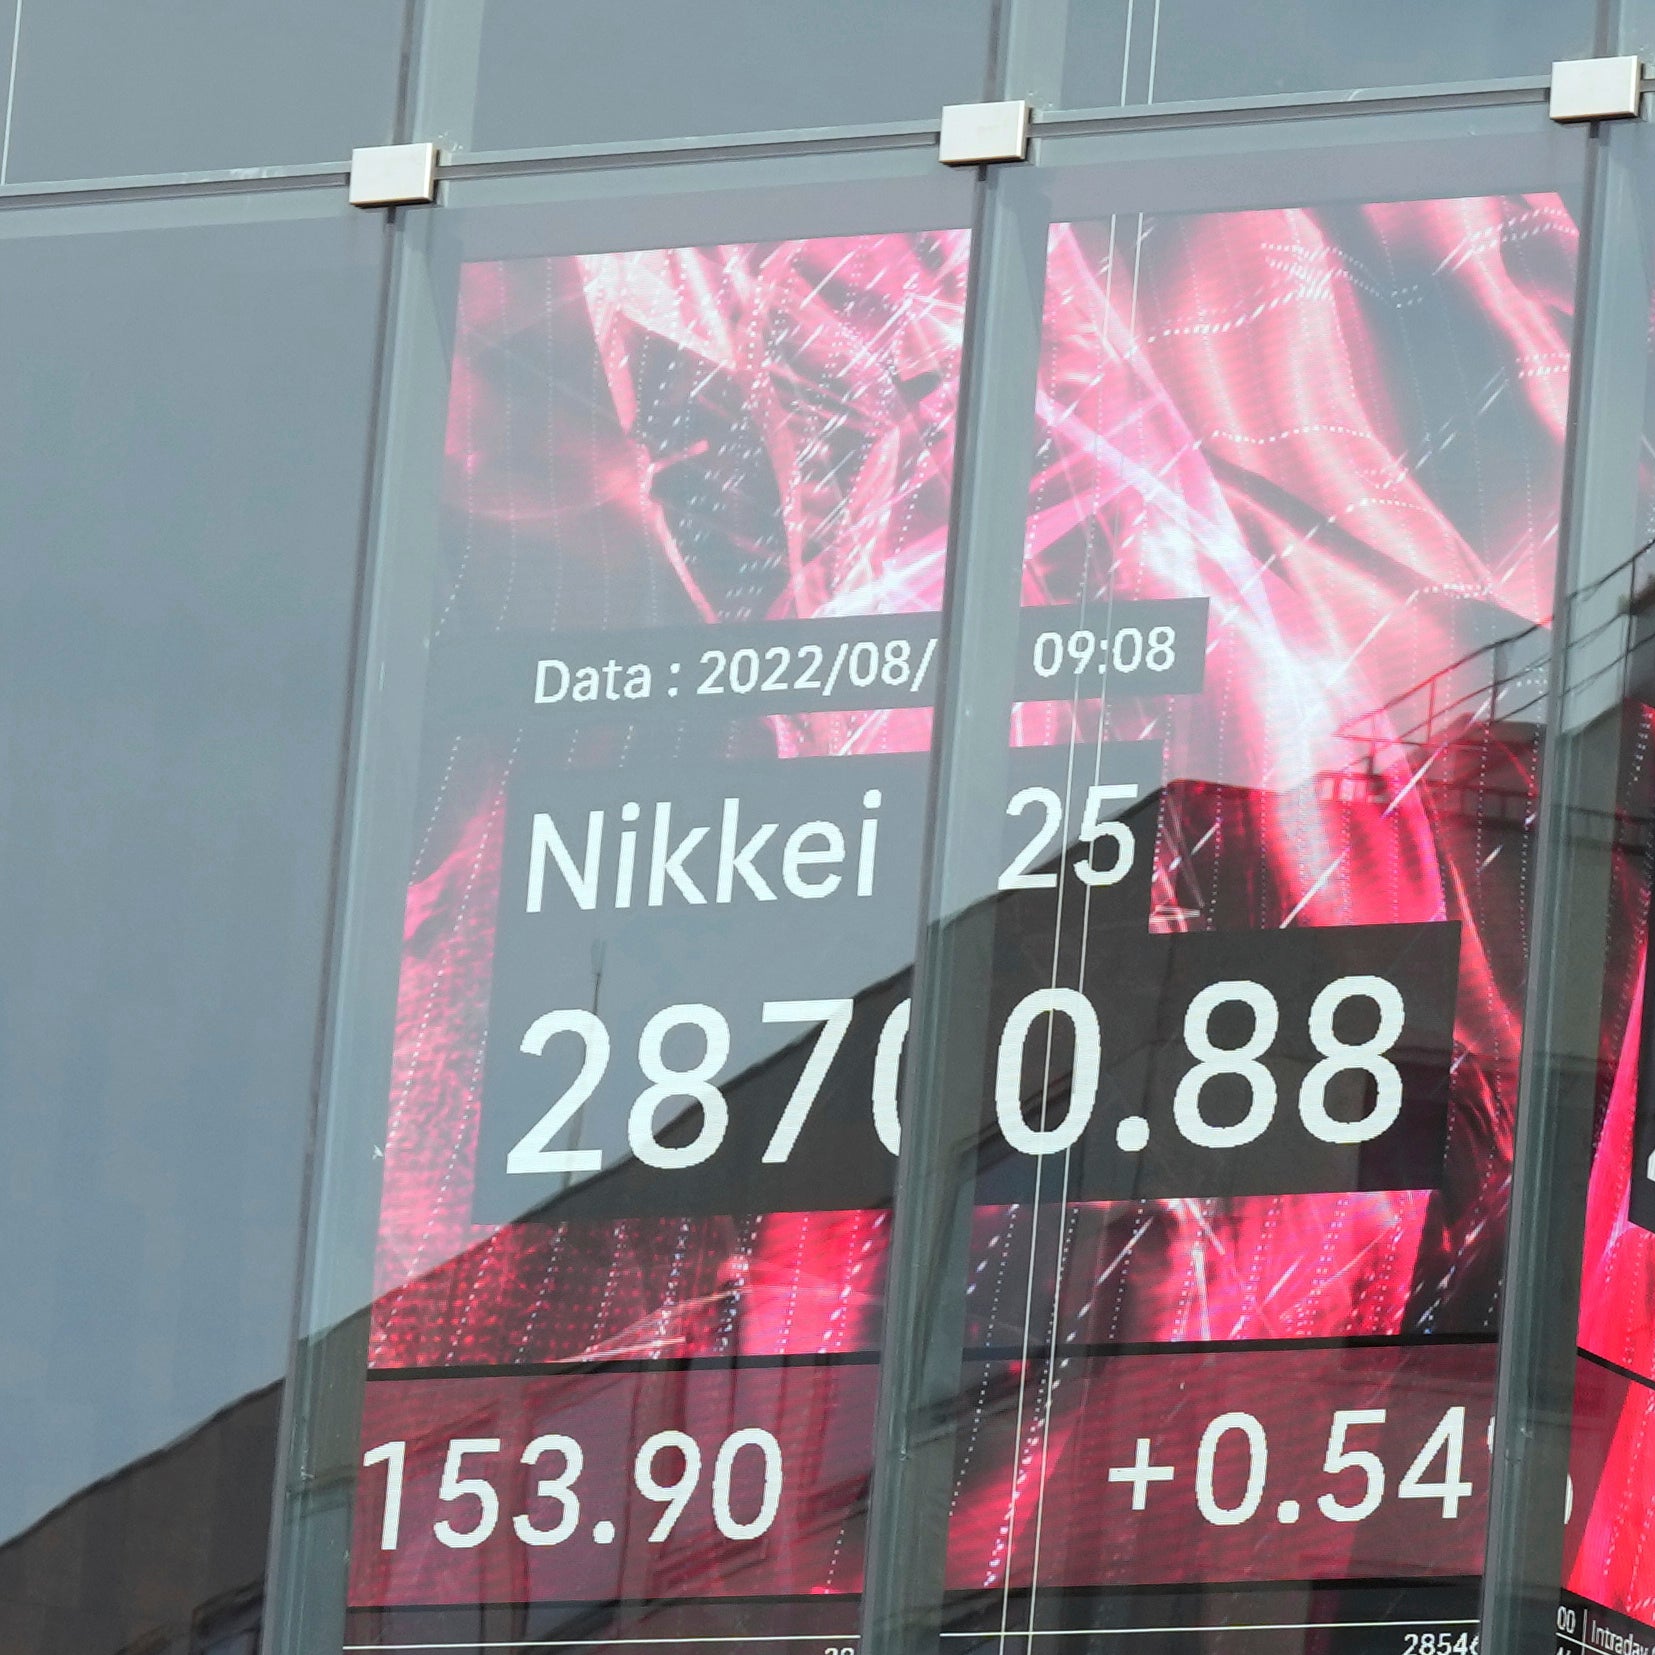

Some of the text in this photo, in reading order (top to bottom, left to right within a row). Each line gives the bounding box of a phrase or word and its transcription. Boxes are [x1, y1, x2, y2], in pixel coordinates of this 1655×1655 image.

[533, 658, 653, 704] Data
[696, 637, 939, 697] 2022/08/
[1032, 625, 1177, 678] 09:08
[525, 783, 1139, 914] Nikkei 25
[362, 1405, 1573, 1551] 153.90 +0.54
